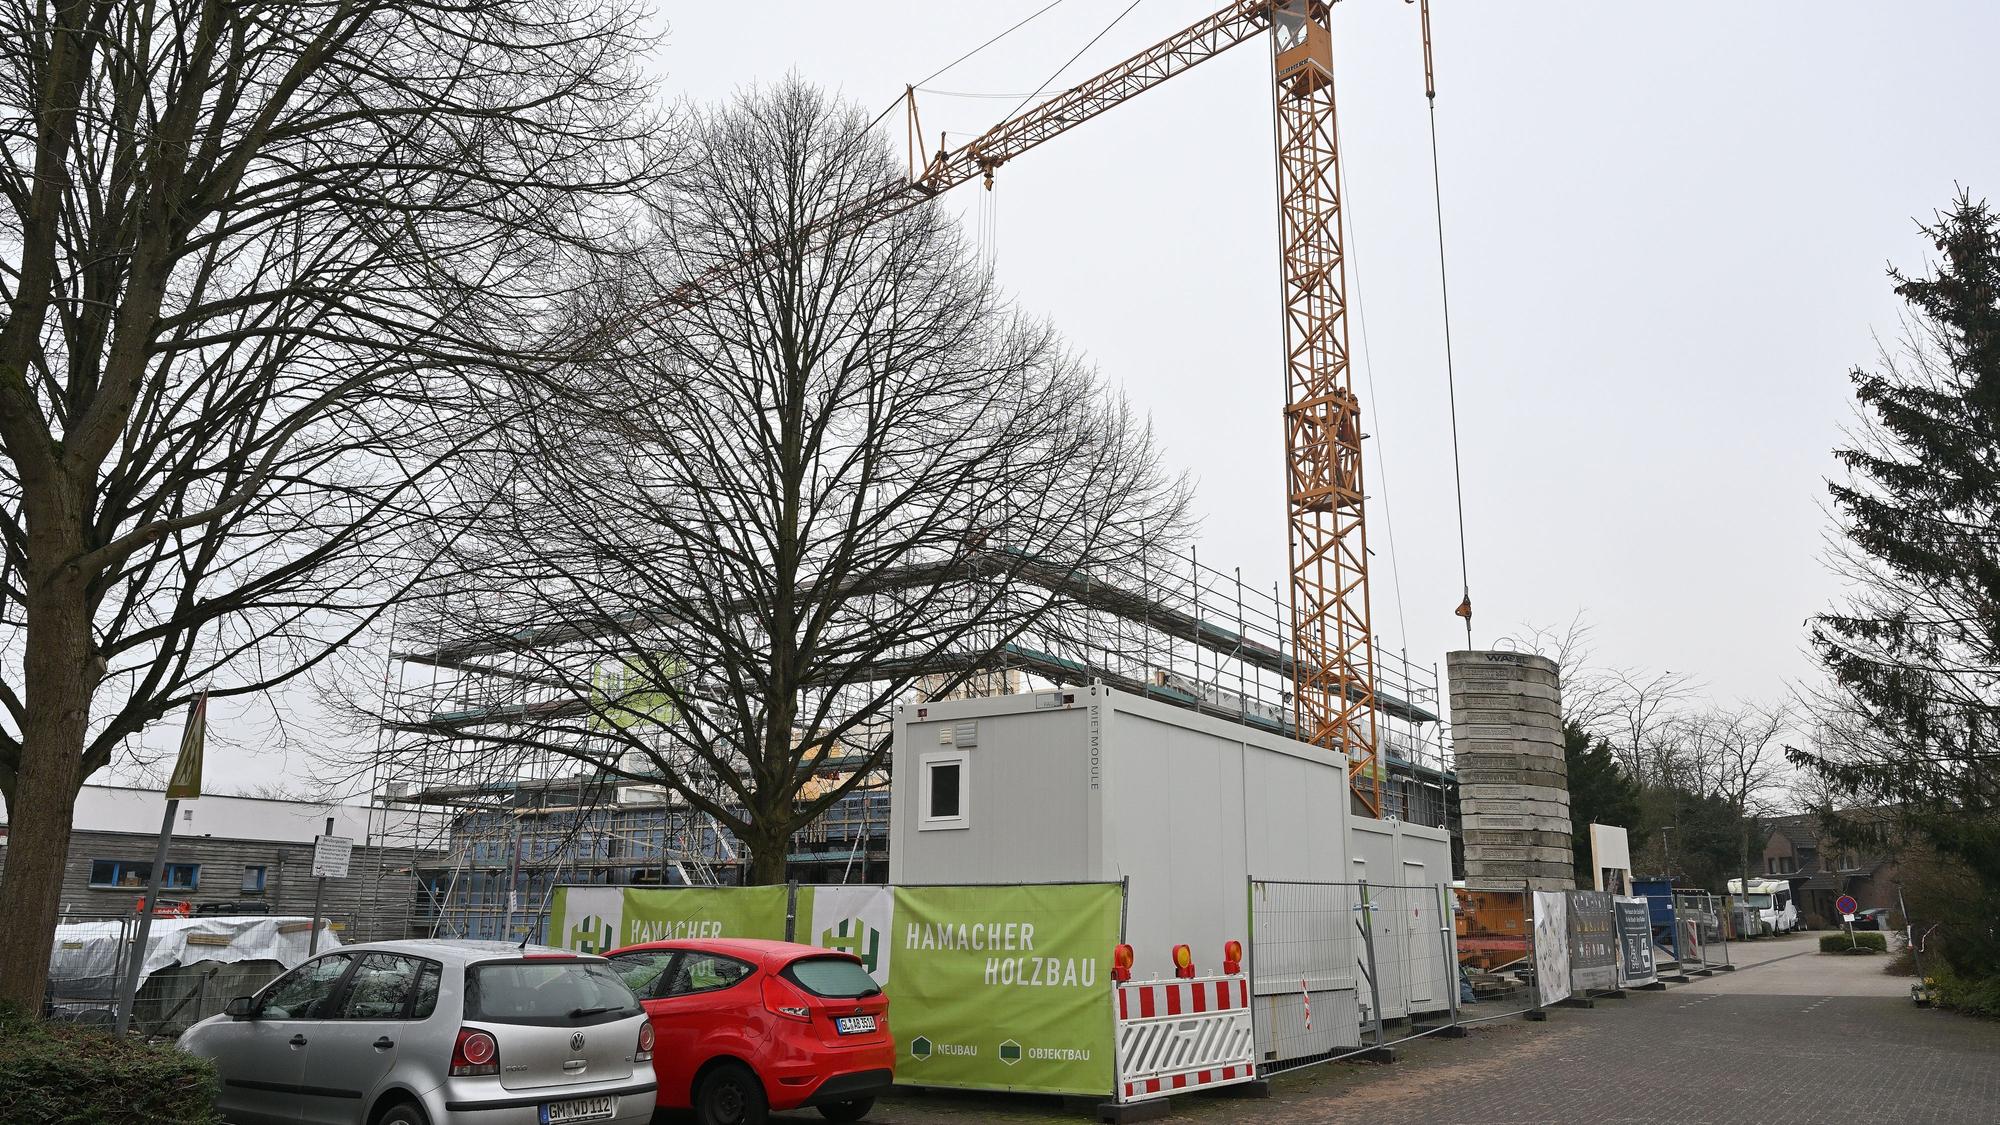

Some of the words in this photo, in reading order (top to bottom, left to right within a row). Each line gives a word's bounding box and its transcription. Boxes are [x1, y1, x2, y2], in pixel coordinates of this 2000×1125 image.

[1091, 705, 1099, 791] MIETMODULE
[631, 920, 722, 943] HAMACHER
[906, 923, 1034, 950] HAMACHER
[984, 958, 1096, 987] HOLZBAU
[938, 1044, 977, 1056] NEUBAU
[1028, 1048, 1090, 1061] OBJEKTBAU
[549, 1104, 566, 1119] GM
[573, 1100, 588, 1117] WD
[590, 1098, 610, 1114] 112
